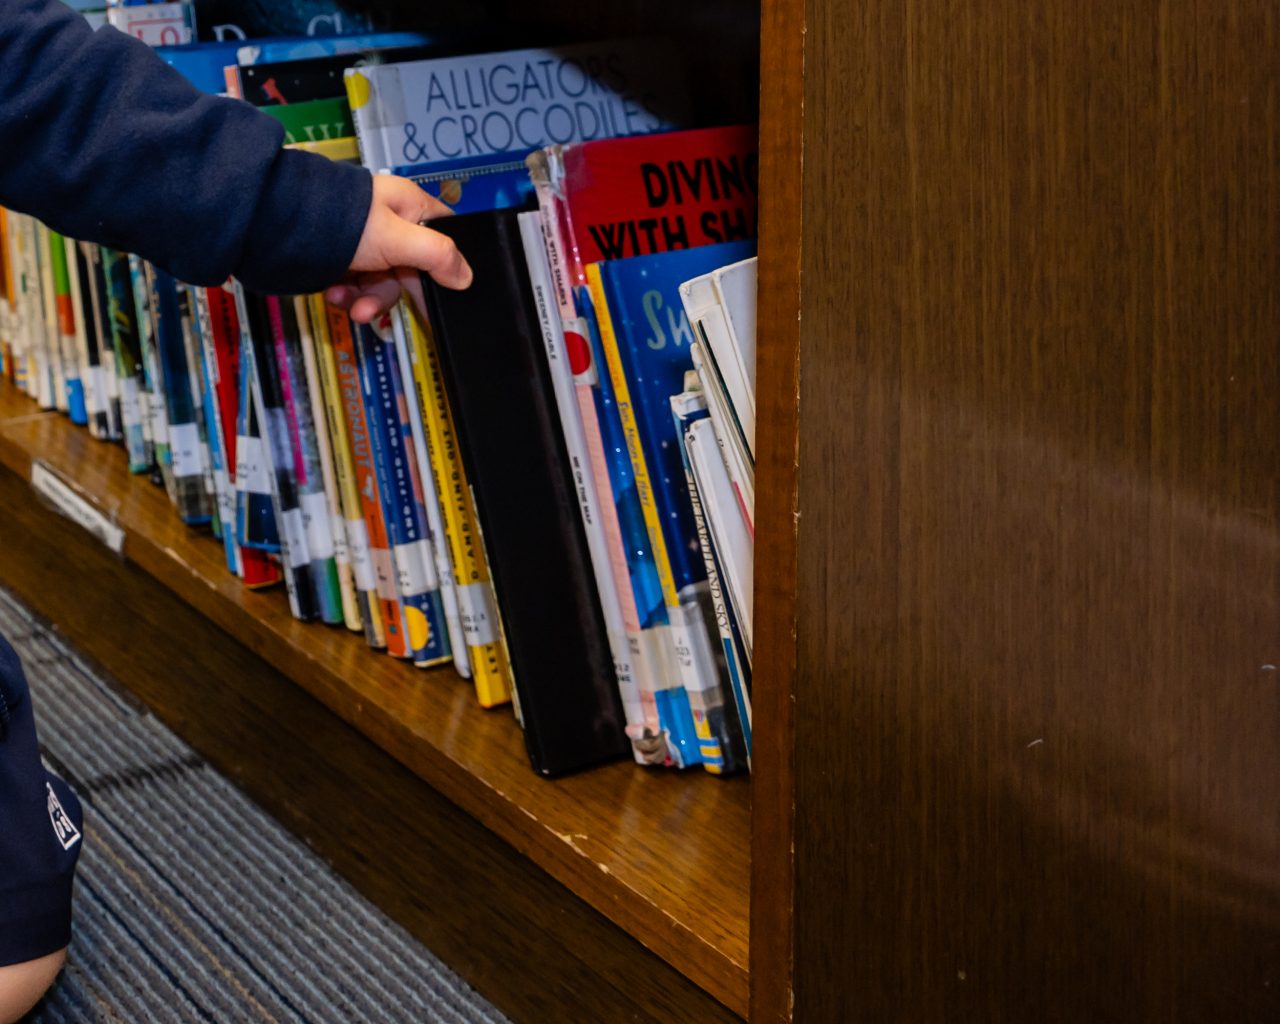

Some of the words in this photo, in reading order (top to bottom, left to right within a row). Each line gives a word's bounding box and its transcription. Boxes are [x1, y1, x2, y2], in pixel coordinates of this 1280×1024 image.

[426, 55, 628, 114] ALLIGATORS
[403, 122, 430, 163] &
[432, 93, 661, 158] CROCODILES
[588, 211, 690, 261] WITH
[535, 285, 549, 325] SWEENEY
[545, 331, 558, 360] CABLE
[338, 350, 372, 467] ASTRONAUT
[706, 563, 721, 599] AND
[715, 603, 730, 632] SKY
